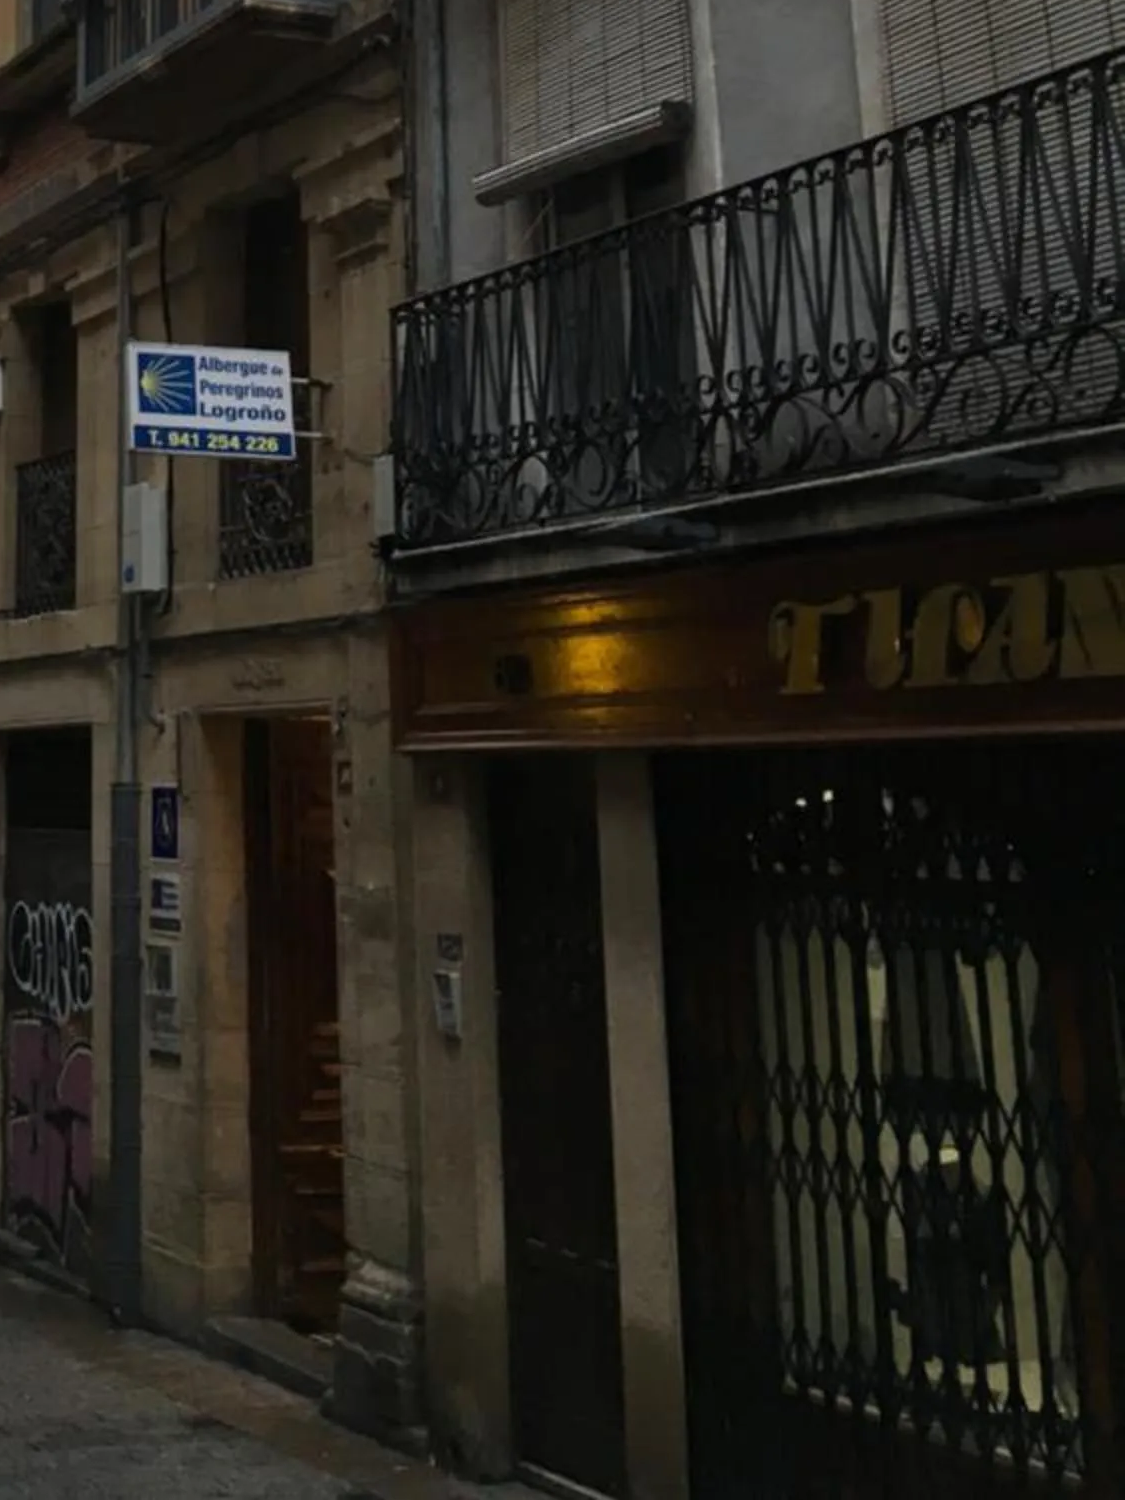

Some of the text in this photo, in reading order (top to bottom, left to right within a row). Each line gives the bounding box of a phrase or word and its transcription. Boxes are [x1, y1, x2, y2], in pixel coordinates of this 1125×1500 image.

[198, 356, 268, 377] Albergue
[199, 379, 284, 400] Peregrinos
[199, 402, 286, 422] Logroño
[167, 431, 200, 448] 941
[206, 433, 240, 451] 254
